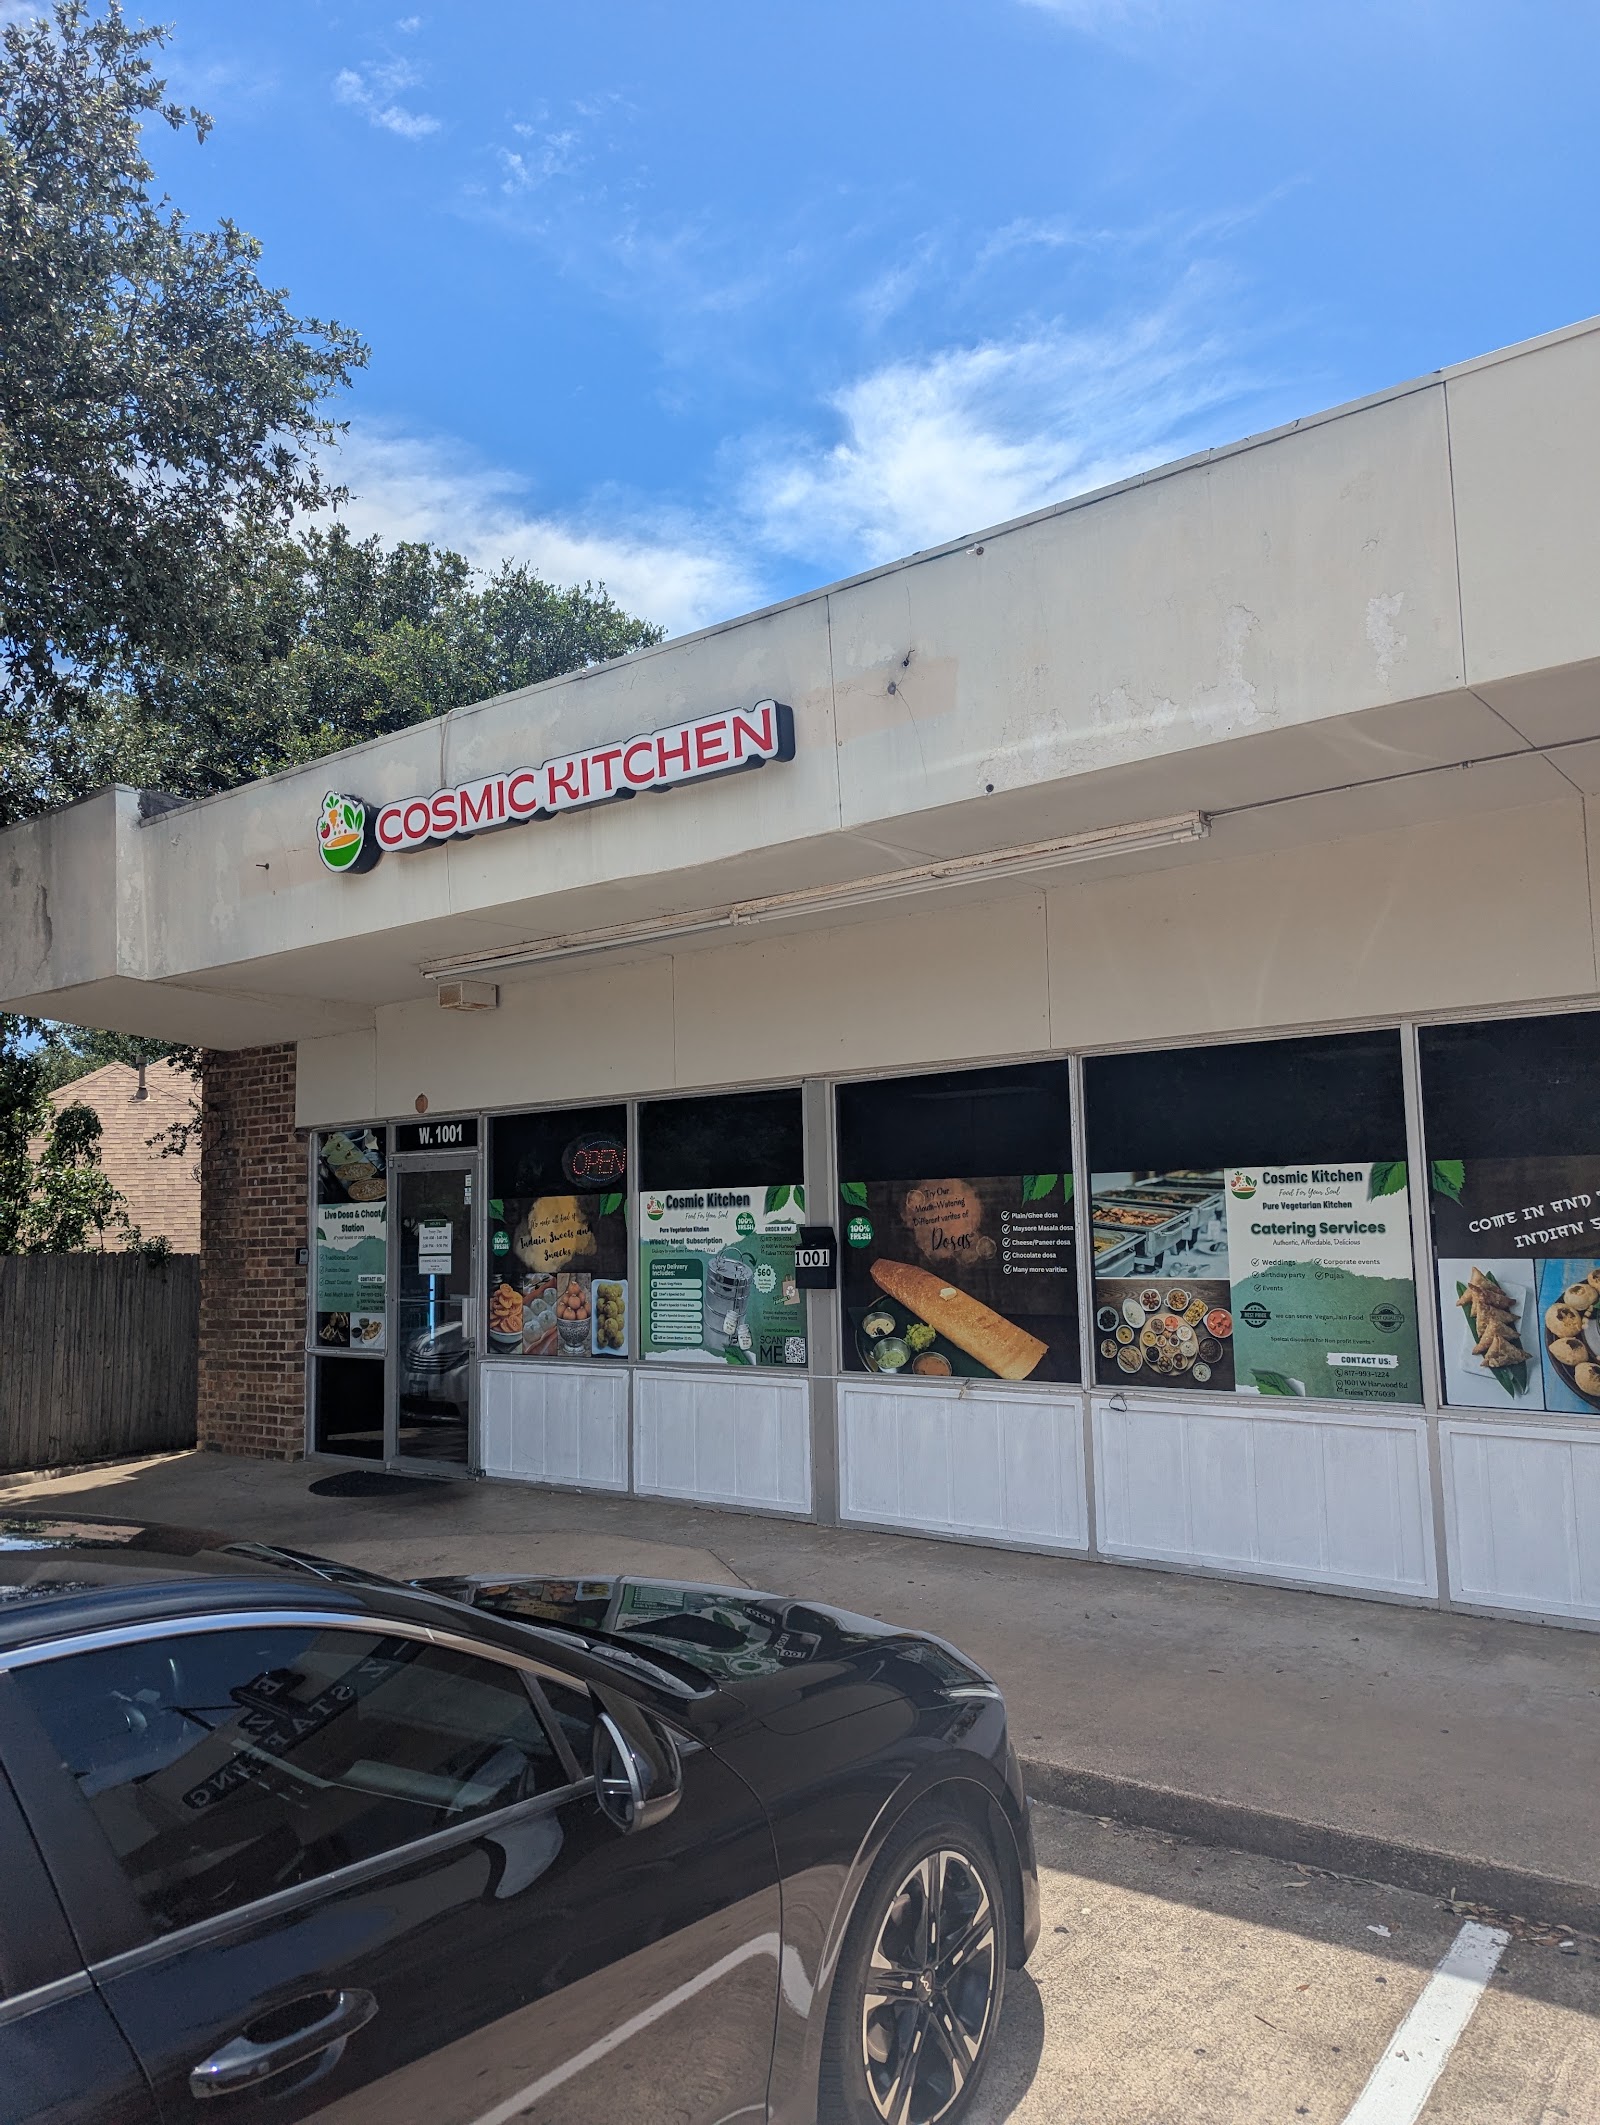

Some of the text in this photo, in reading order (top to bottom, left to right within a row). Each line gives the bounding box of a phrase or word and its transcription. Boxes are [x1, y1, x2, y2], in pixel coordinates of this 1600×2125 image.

[378, 707, 774, 845] COSMIC KITCHEN
[418, 1124, 462, 1144] W. 1001
[573, 1149, 626, 1175] OPEN
[1263, 1170, 1363, 1184] Cosmic Kitchen
[924, 1187, 950, 1198] Try Our
[1278, 1186, 1341, 1198] Food For Your Soul
[666, 1192, 750, 1209] Cosmic Kitchen
[915, 1198, 966, 1212] Mouth-Watering
[1263, 1201, 1352, 1211] Pure Vegetarian Kitchen
[324, 1210, 381, 1220] Live Dosa & Chaat
[685, 1212, 696, 1220] Food
[706, 1212, 717, 1221] Your
[718, 1211, 729, 1219] Soul
[1468, 1194, 1592, 1233] COME IN AND
[342, 1223, 365, 1232] Station
[550, 1230, 574, 1243] Sweets
[576, 1224, 593, 1235] and
[1251, 1220, 1386, 1238] Catering Services
[932, 1227, 972, 1251] Dosas
[1514, 1221, 1584, 1248] INDIAN
[686, 1237, 723, 1246] Subscription
[1334, 1238, 1361, 1246] Delicious
[544, 1248, 572, 1261] Snacks
[796, 1250, 828, 1266] 1001
[667, 1263, 688, 1271] Delivery
[1262, 1259, 1296, 1267] Weddings
[758, 1268, 771, 1277] $60
[1324, 1272, 1344, 1280] Pujas
[760, 1336, 782, 1344] SCAN
[760, 1346, 782, 1364] ME
[1341, 1356, 1376, 1364] CONTACT
[1368, 1380, 1398, 1388] Harwood
